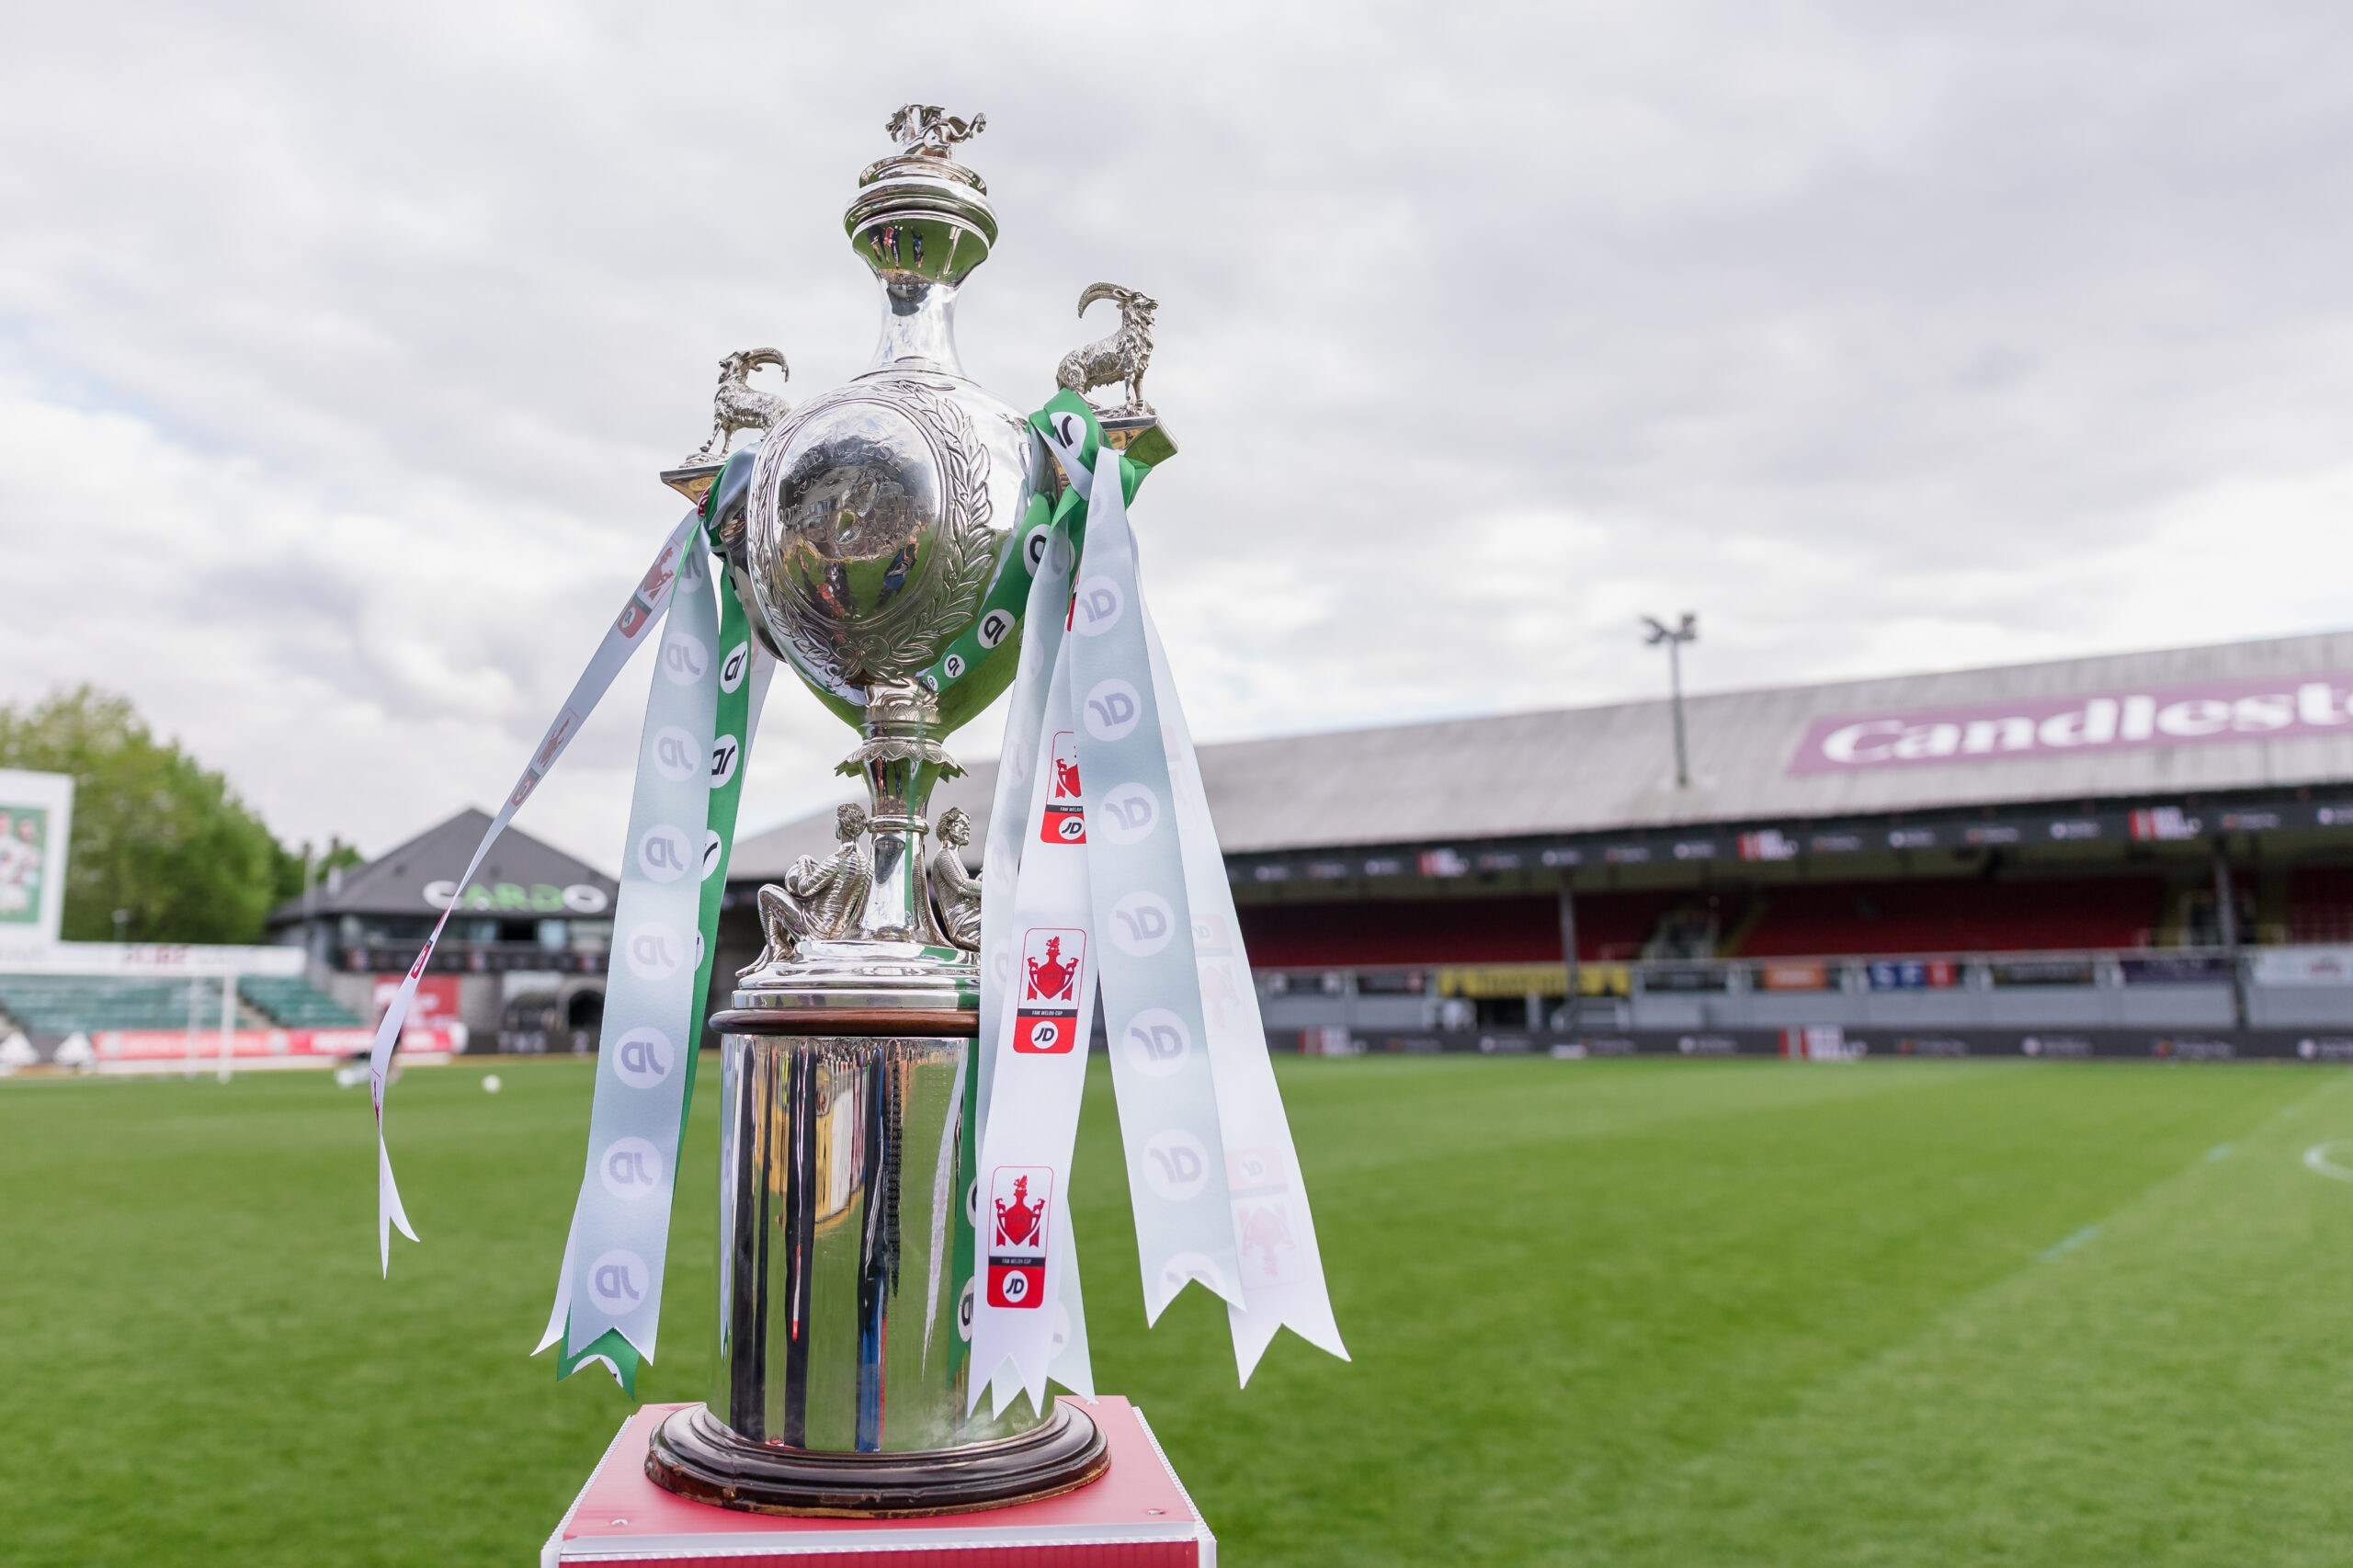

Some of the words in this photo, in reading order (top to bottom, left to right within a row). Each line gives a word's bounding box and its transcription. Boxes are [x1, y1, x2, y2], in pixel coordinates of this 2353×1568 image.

[724, 649, 747, 682] JD
[1822, 680, 2353, 765] Candlest
[1061, 822, 1083, 835] JD
[423, 880, 608, 914] CARDO
[1034, 1027, 1055, 1042] JD
[1006, 1278, 1024, 1294] JD
